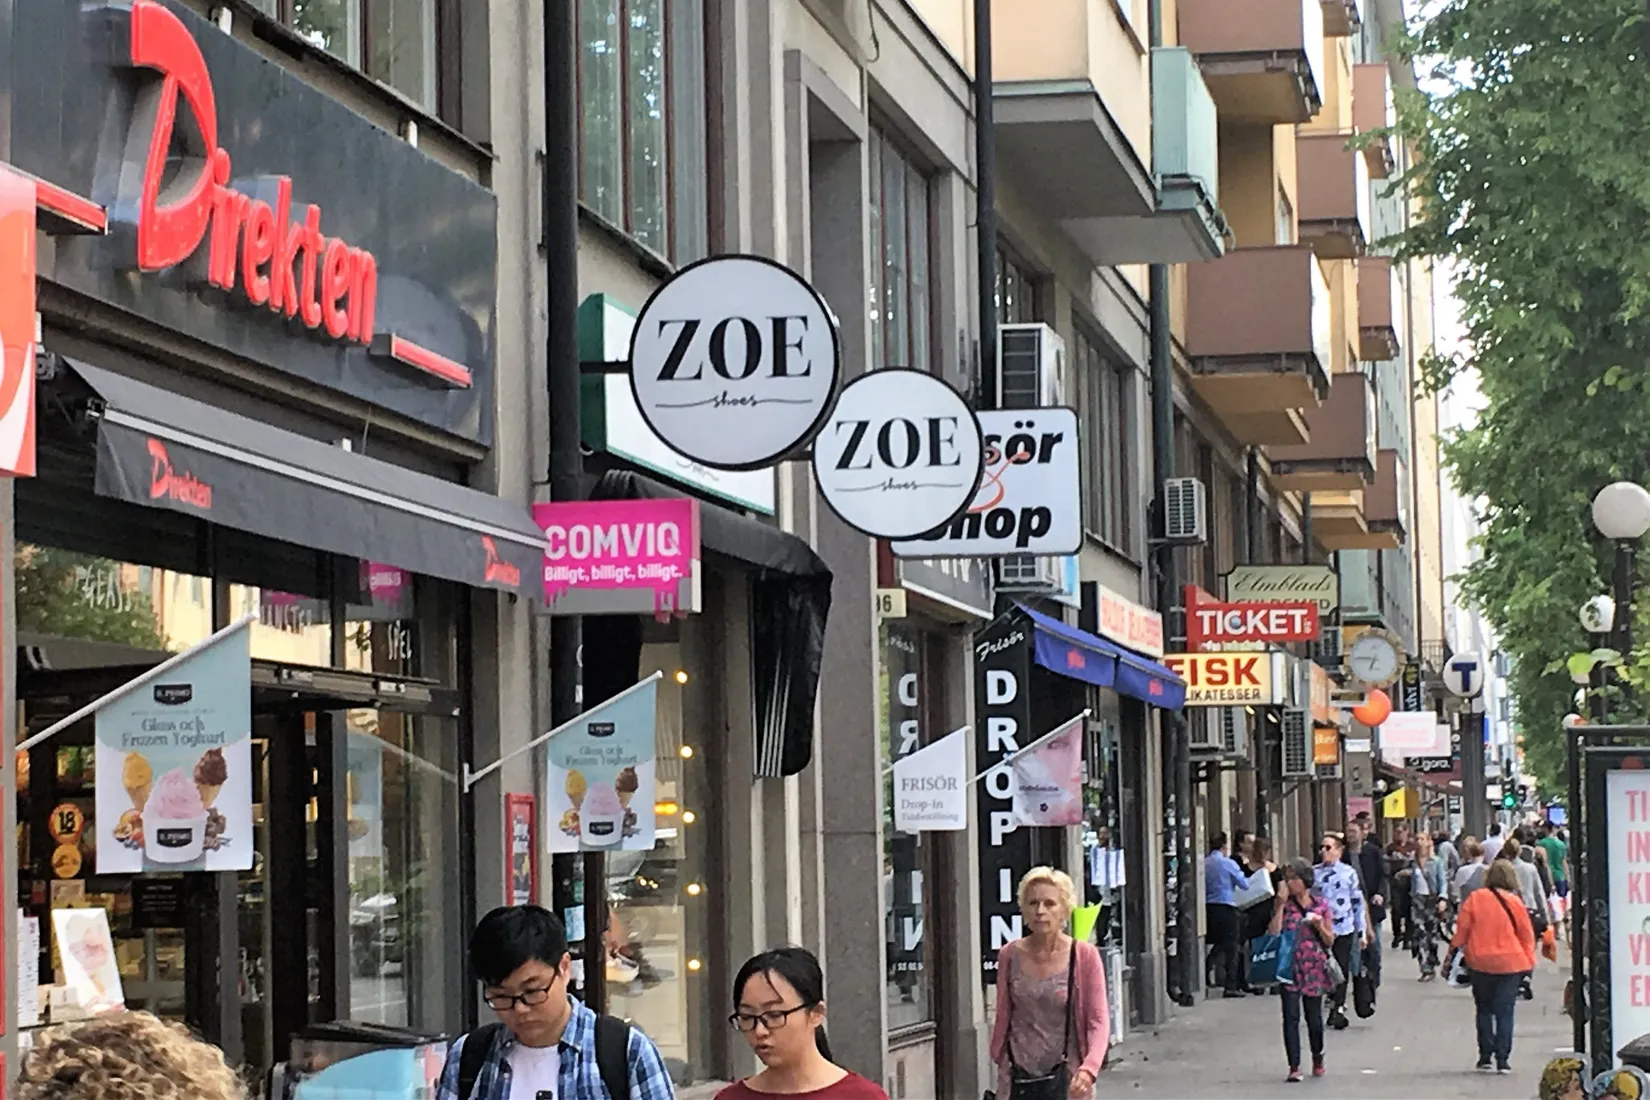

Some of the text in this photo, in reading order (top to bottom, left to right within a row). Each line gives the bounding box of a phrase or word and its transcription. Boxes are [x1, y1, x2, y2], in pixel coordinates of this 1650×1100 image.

[131, 0, 377, 346] Direkten
[656, 316, 812, 382] ZOE
[712, 390, 759, 408] shoes
[835, 416, 961, 471] ZOE
[880, 477, 919, 492] shoes
[545, 521, 682, 560] COMVIQ
[545, 561, 683, 584] Billigt, billigt, billigt.
[1234, 573, 1331, 592] Elmblads
[1196, 609, 1308, 635] TICKET
[1164, 658, 1262, 687] FISK
[1452, 661, 1478, 693] T
[1186, 688, 1262, 701] IKATESSER
[122, 732, 168, 747] Frozen
[59, 811, 75, 833] 18
